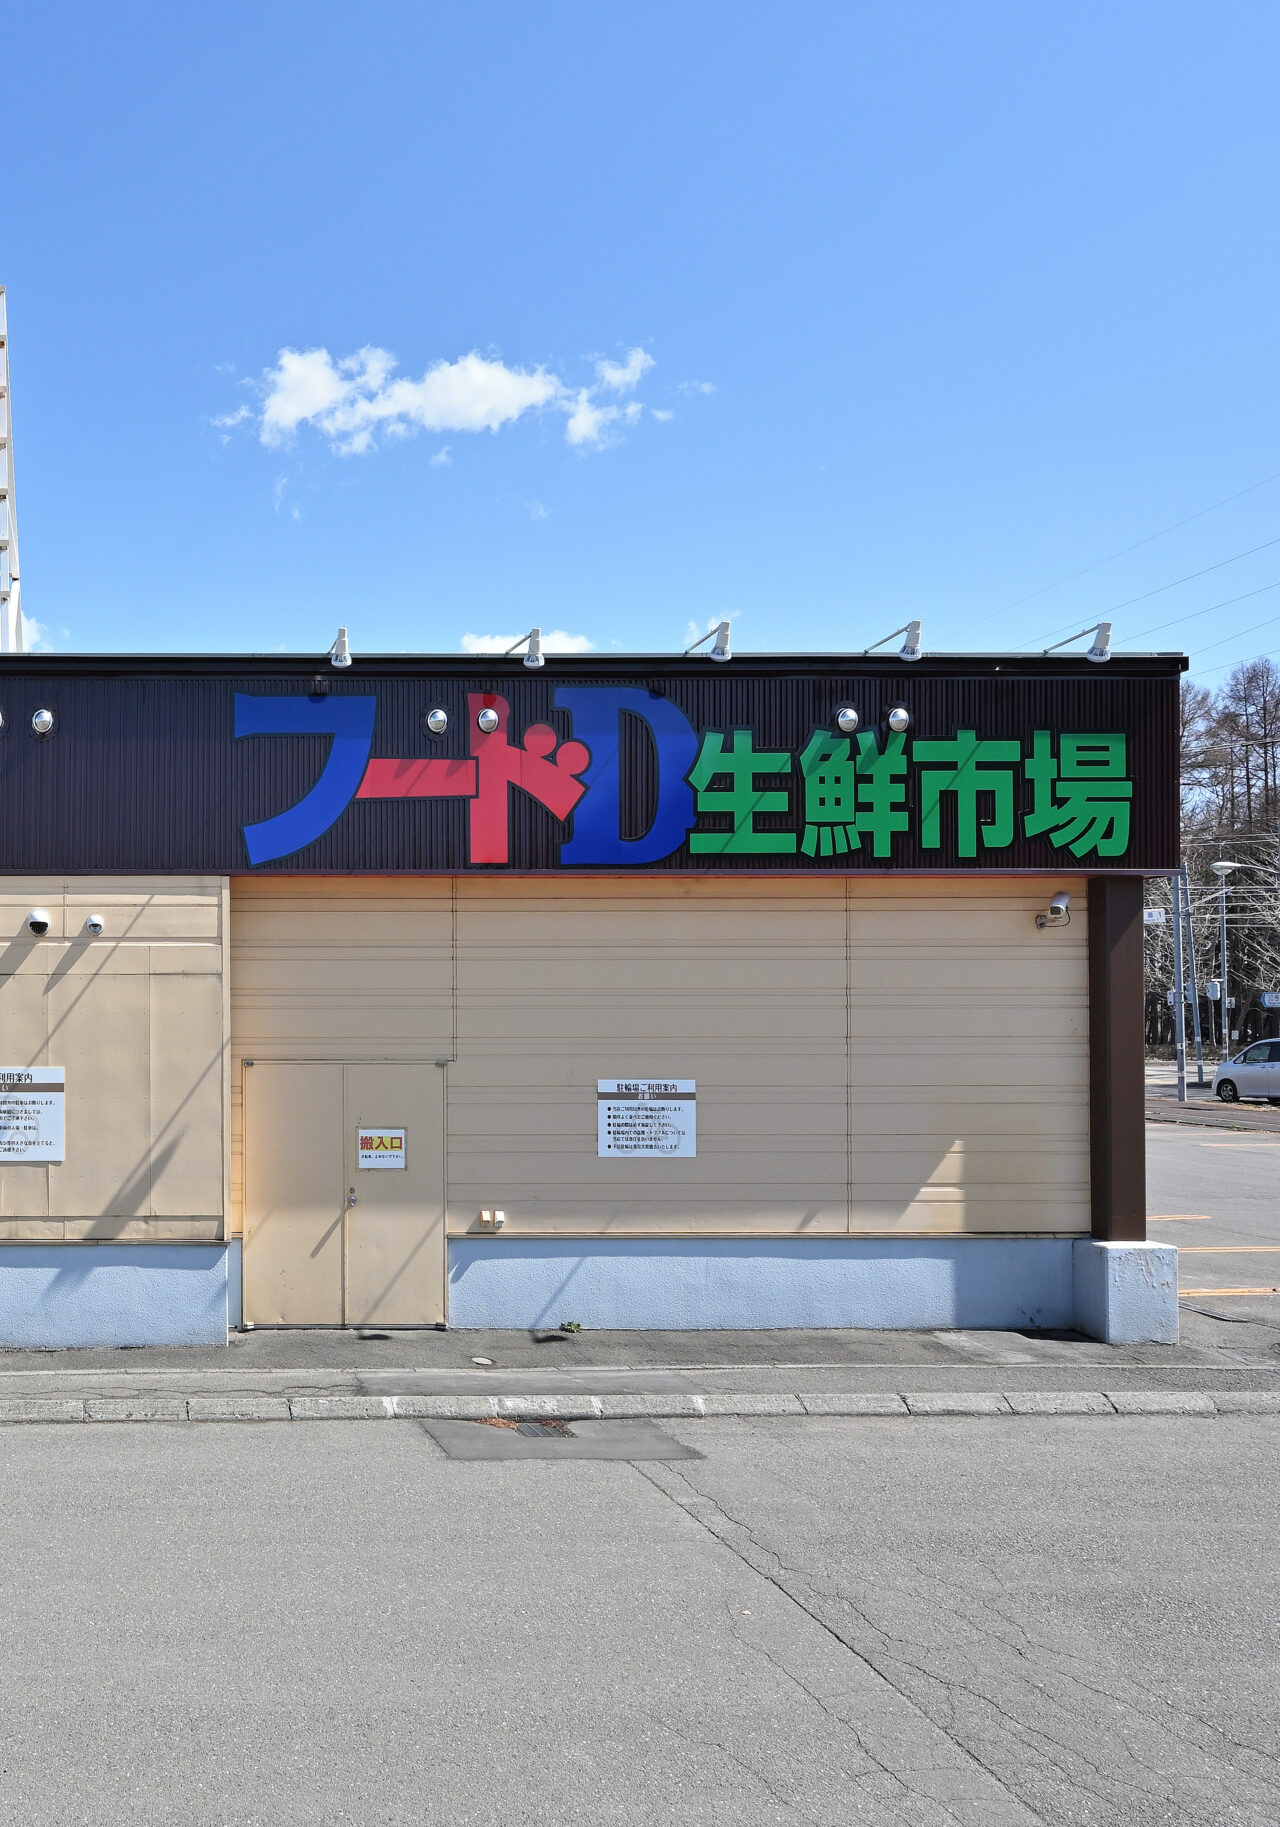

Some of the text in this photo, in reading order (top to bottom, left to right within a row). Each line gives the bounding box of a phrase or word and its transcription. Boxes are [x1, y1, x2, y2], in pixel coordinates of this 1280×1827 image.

[616, 1083, 678, 1092] 駐輪場ご利用案内
[360, 1136, 403, 1150] 搬入口
